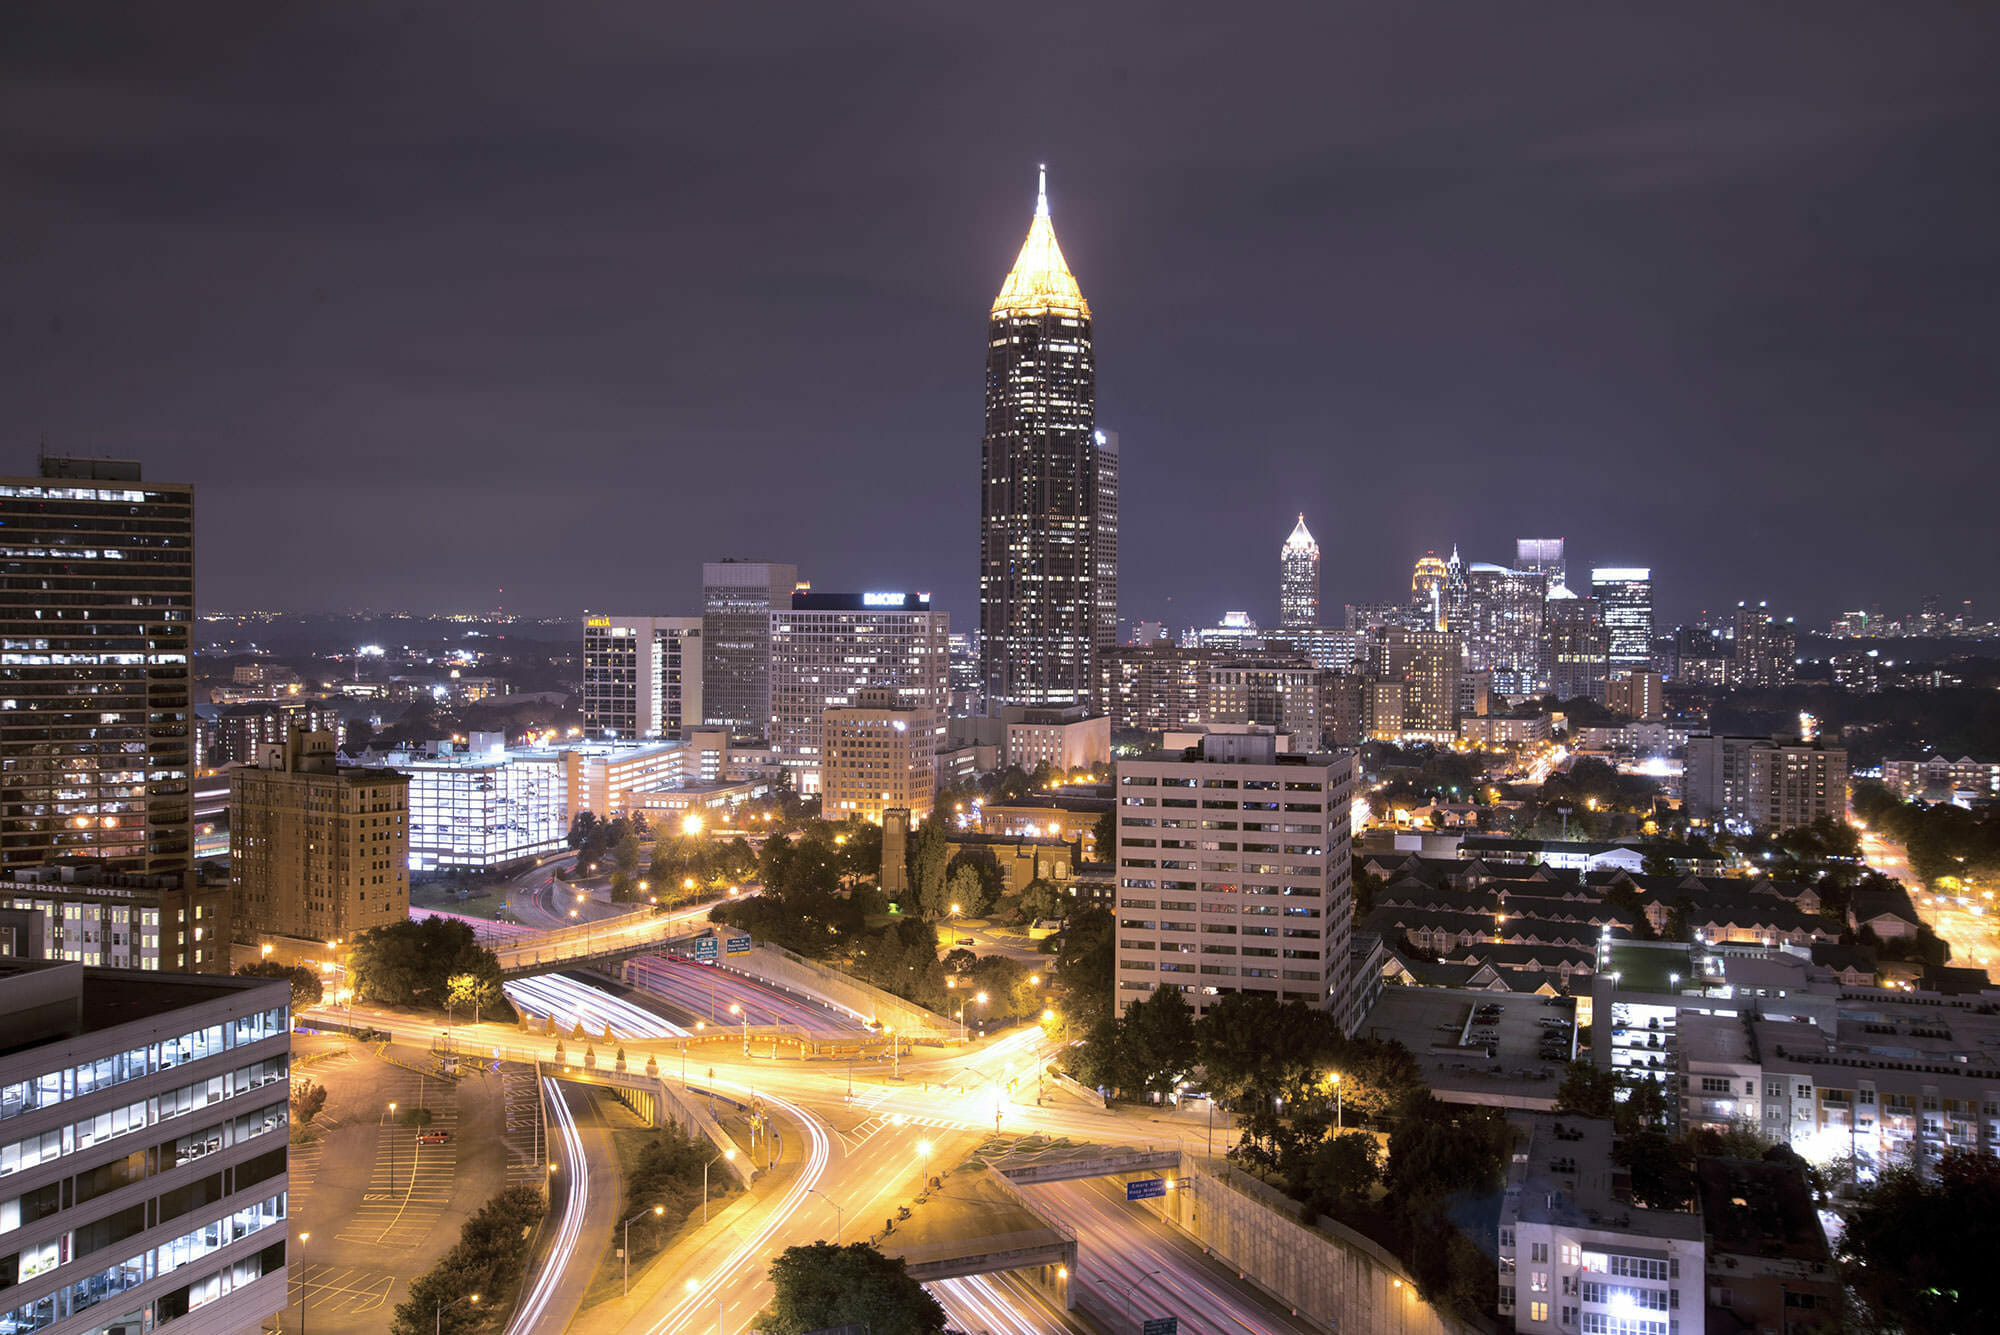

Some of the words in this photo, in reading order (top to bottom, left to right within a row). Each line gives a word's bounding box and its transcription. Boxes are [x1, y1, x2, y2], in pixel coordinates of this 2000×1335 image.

[863, 592, 905, 605] EMORY
[0, 881, 72, 893] IMPERIAL
[86, 888, 135, 897] HOTEL
